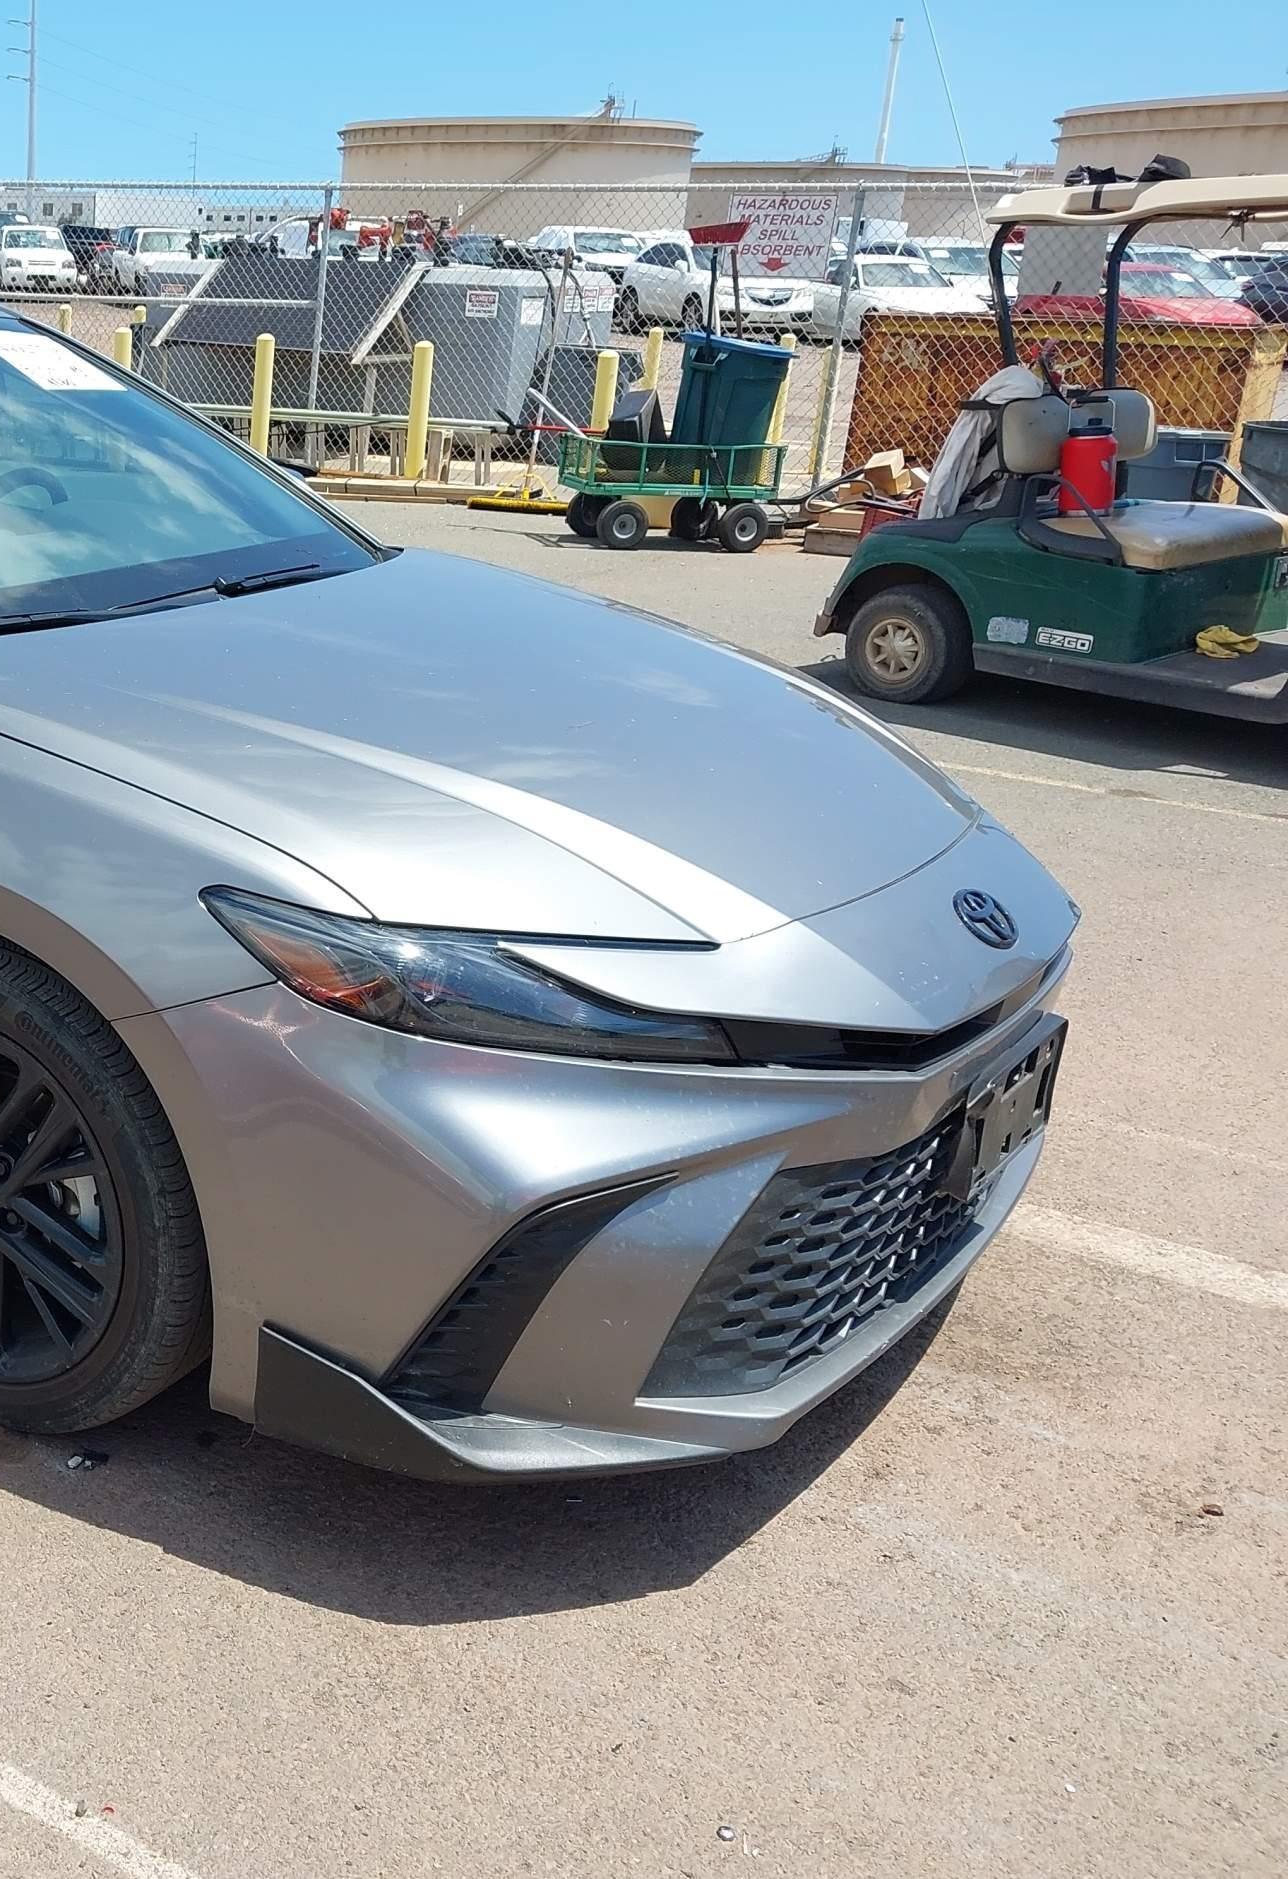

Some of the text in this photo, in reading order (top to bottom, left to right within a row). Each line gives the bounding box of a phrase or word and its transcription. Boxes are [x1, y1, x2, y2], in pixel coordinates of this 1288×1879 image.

[736, 199, 832, 210] HAZARDOUS
[739, 214, 825, 226] MATERIALS
[758, 229, 799, 241] SPILL
[733, 244, 824, 256] BSORBENT
